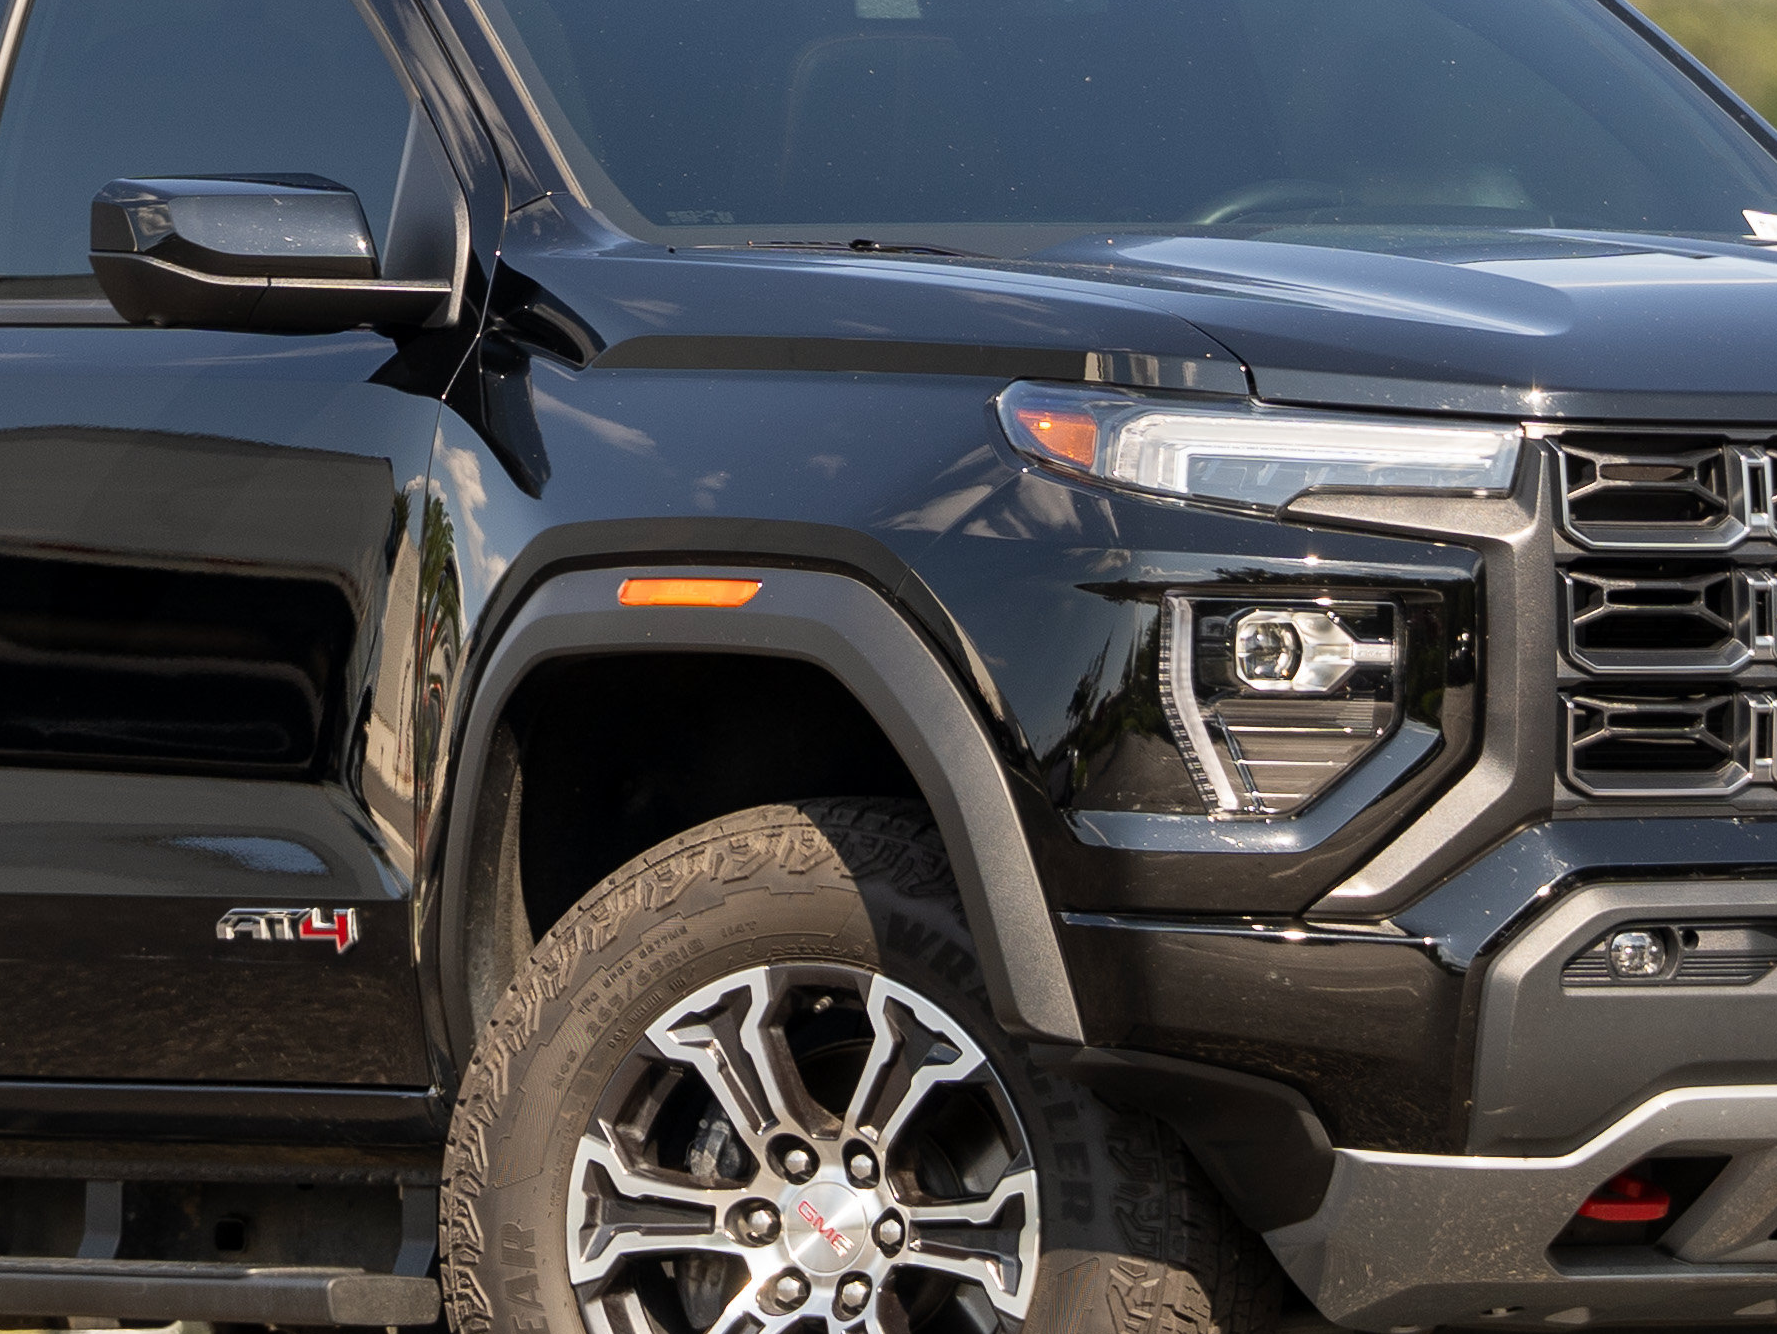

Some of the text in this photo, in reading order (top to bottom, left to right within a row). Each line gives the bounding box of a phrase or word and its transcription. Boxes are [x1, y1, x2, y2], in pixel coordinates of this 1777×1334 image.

[216, 907, 359, 954] AT4
[884, 911, 1094, 1226] WRAGLER
[798, 1200, 854, 1257] GMC
